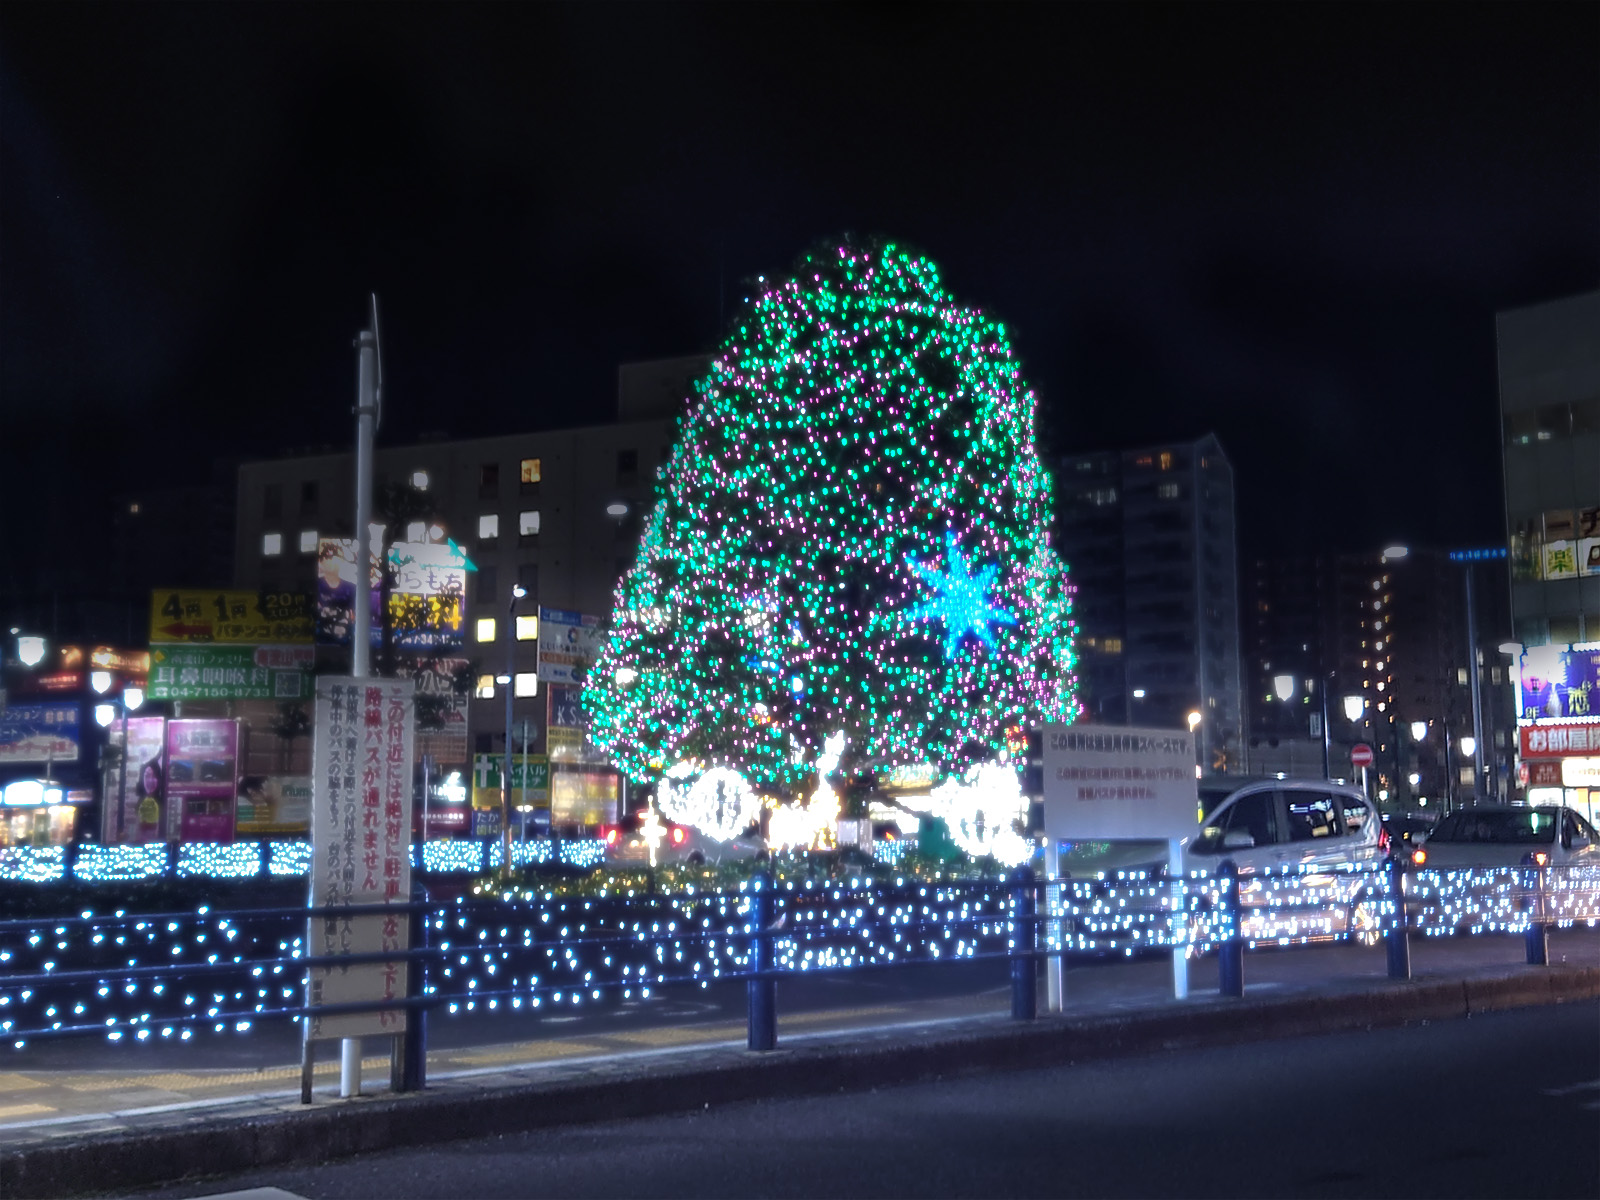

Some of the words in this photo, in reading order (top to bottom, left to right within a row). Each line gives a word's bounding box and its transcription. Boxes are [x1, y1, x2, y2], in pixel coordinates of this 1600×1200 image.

[362, 685, 383, 891] 路線バスが通れません
